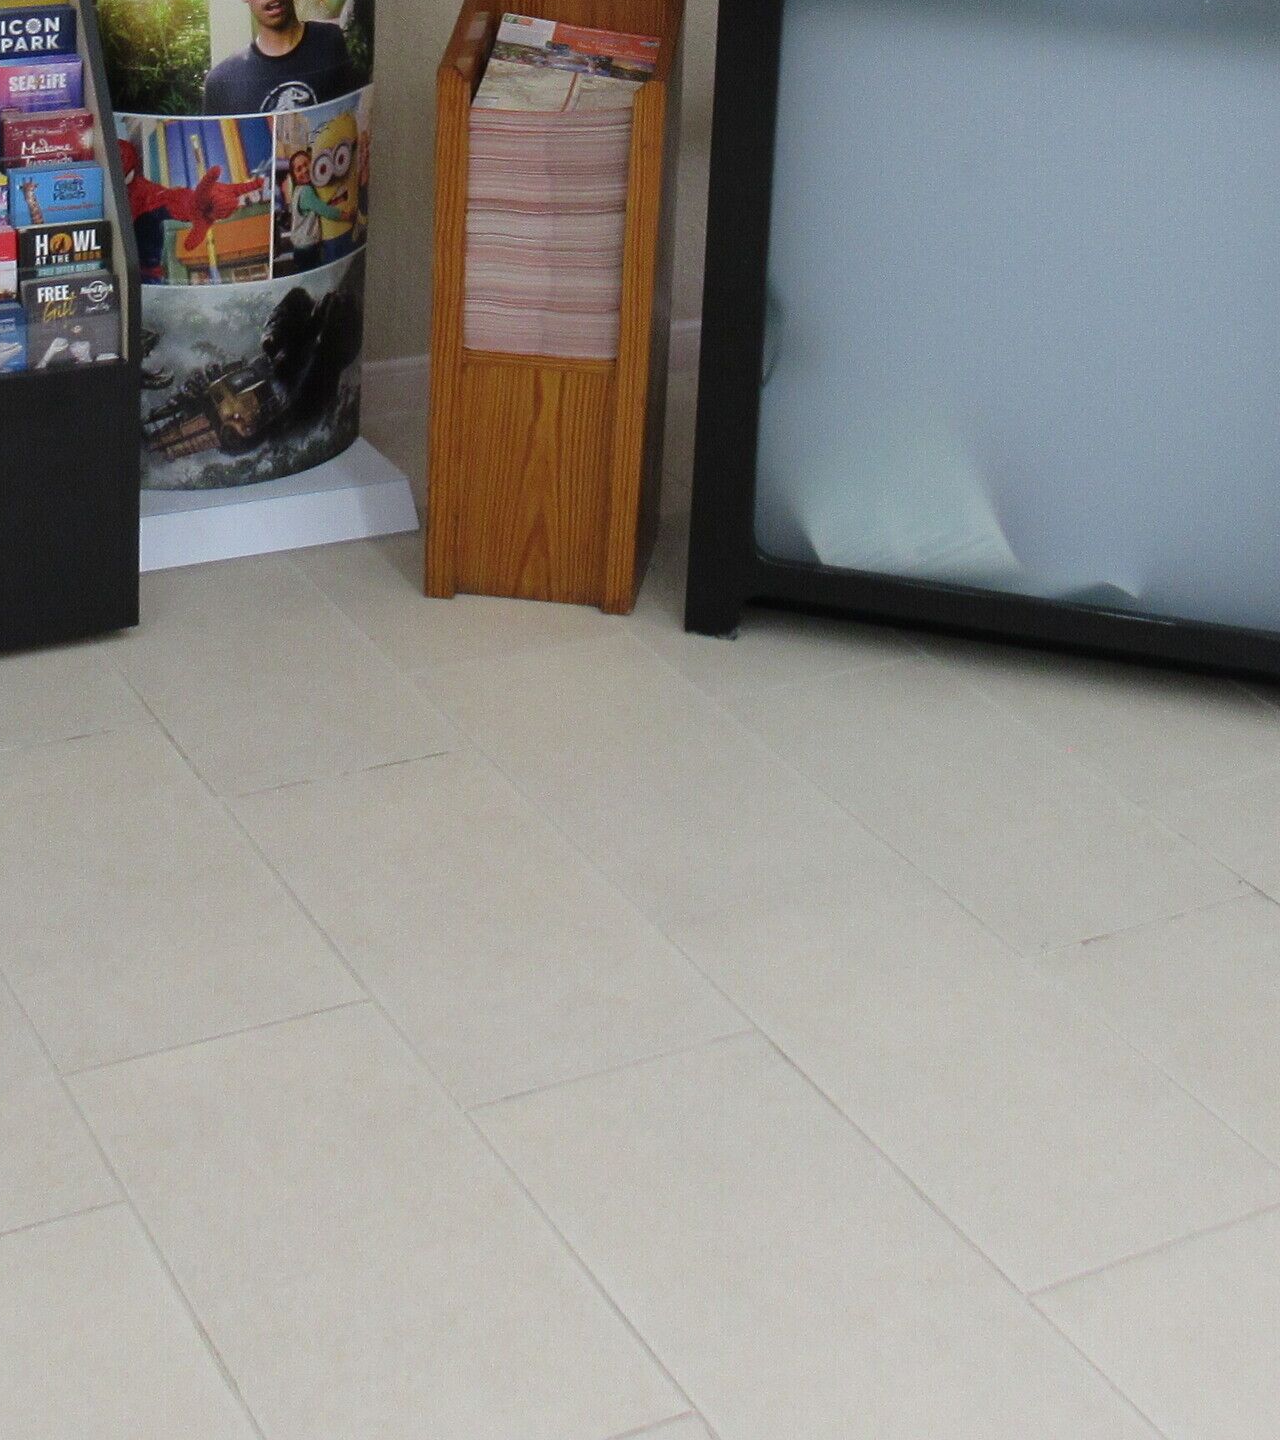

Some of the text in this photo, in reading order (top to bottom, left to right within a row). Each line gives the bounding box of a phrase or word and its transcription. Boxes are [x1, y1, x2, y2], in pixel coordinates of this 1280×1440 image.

[0, 17, 61, 36] ICON
[0, 33, 59, 53] PARK
[9, 76, 35, 92] SEA
[21, 138, 74, 155] Madame
[35, 229, 101, 257] HOWL
[35, 253, 70, 266] AT THE
[37, 284, 70, 303] FREE
